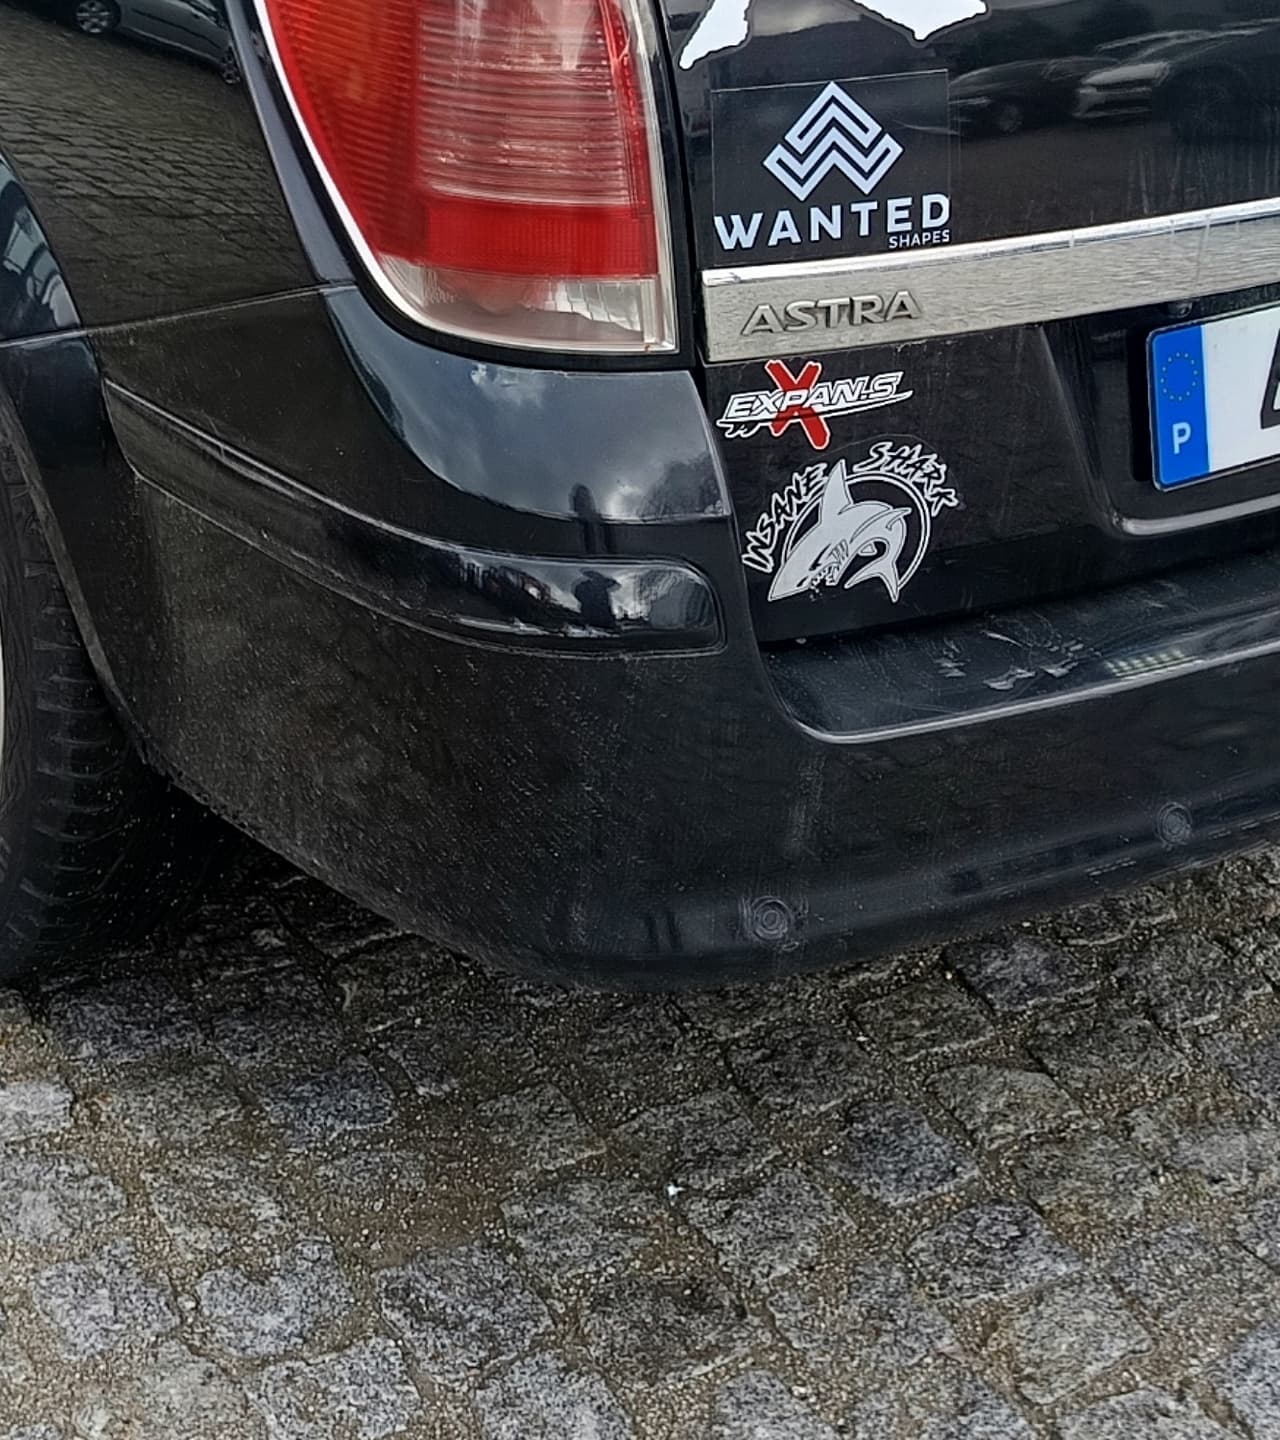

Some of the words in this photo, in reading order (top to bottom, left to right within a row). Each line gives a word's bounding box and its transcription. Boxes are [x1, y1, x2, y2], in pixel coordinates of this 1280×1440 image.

[713, 193, 951, 251] WANTED
[888, 228, 950, 249] SHAPES
[742, 290, 919, 336] ASTRA
[1171, 421, 1192, 455] P
[741, 463, 828, 574] INSANE
